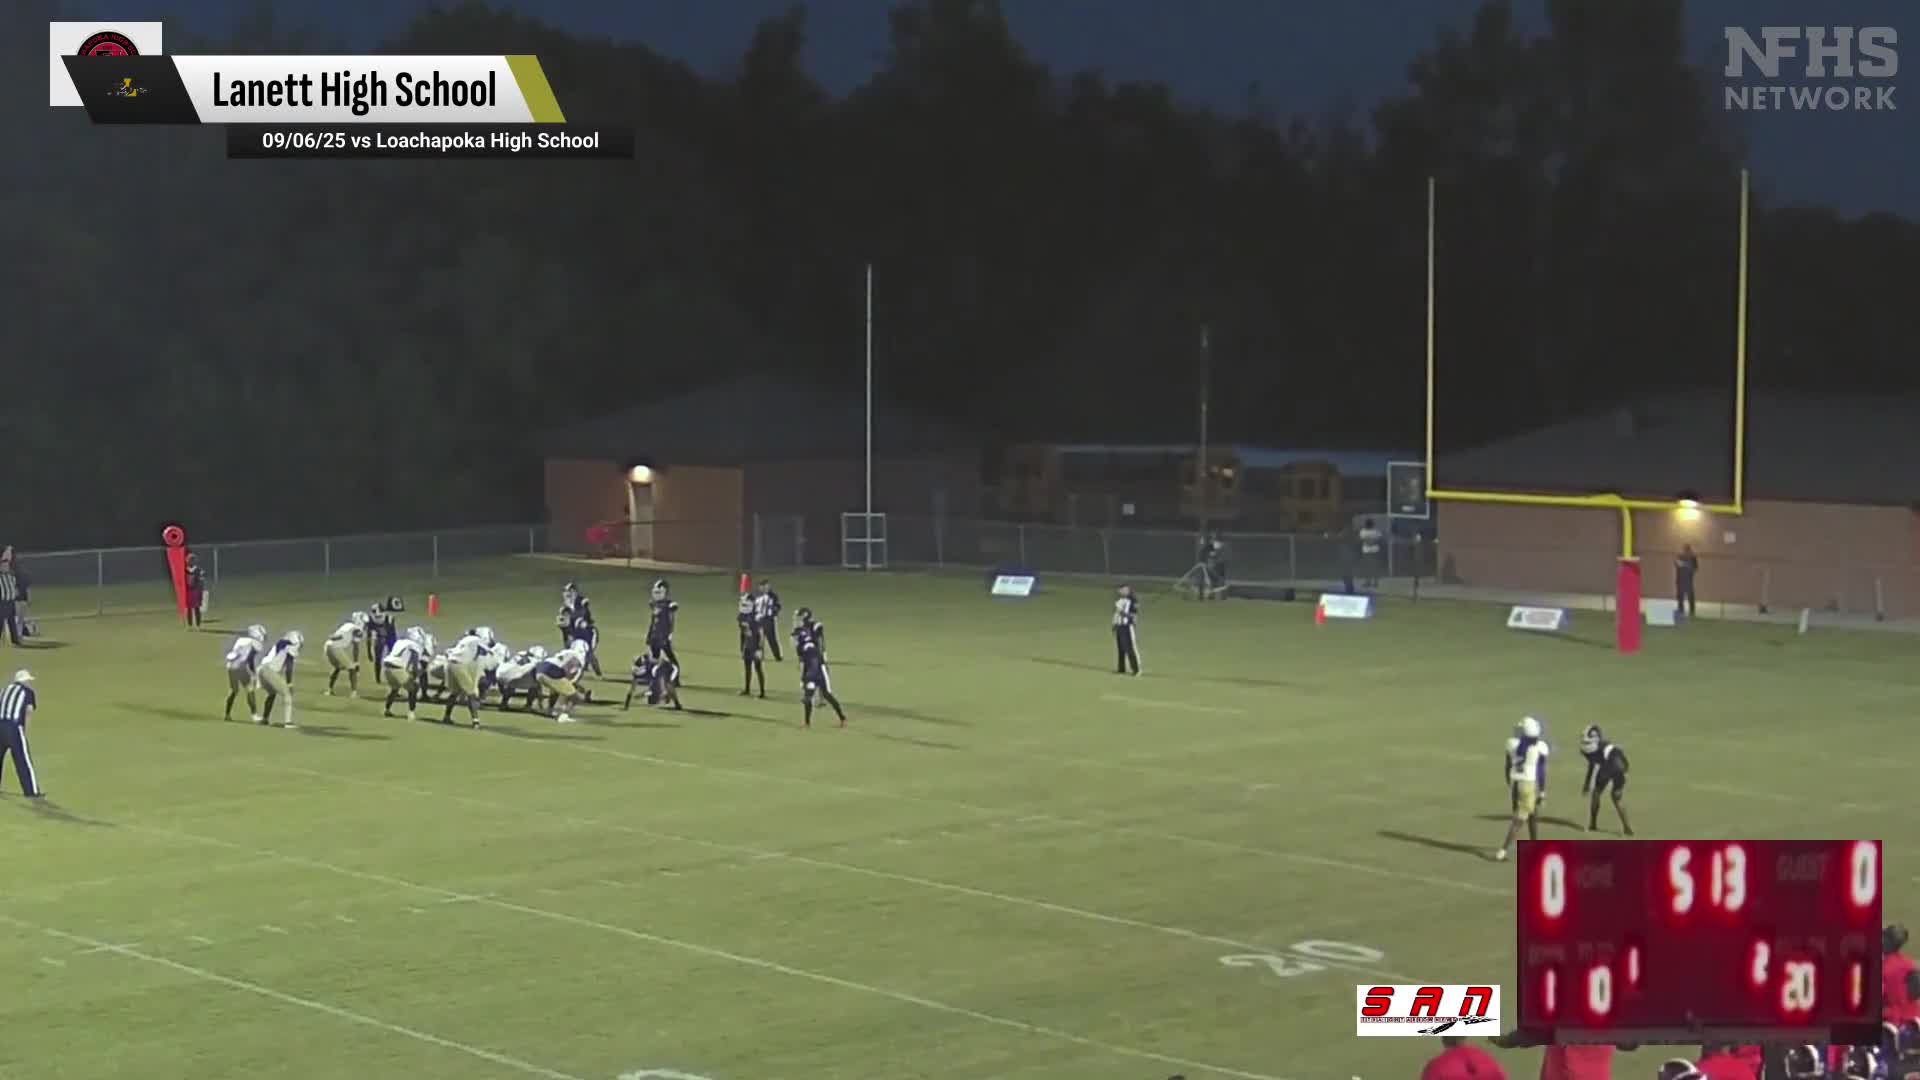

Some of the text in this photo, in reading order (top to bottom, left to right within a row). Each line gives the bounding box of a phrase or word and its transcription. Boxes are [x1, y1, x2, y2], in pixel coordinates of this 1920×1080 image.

[1541, 854, 1565, 919] 0
[1669, 846, 1694, 913] 5
[1852, 841, 1877, 907] 0
[1218, 940, 1384, 977] 20
[1588, 965, 1612, 1014] 0
